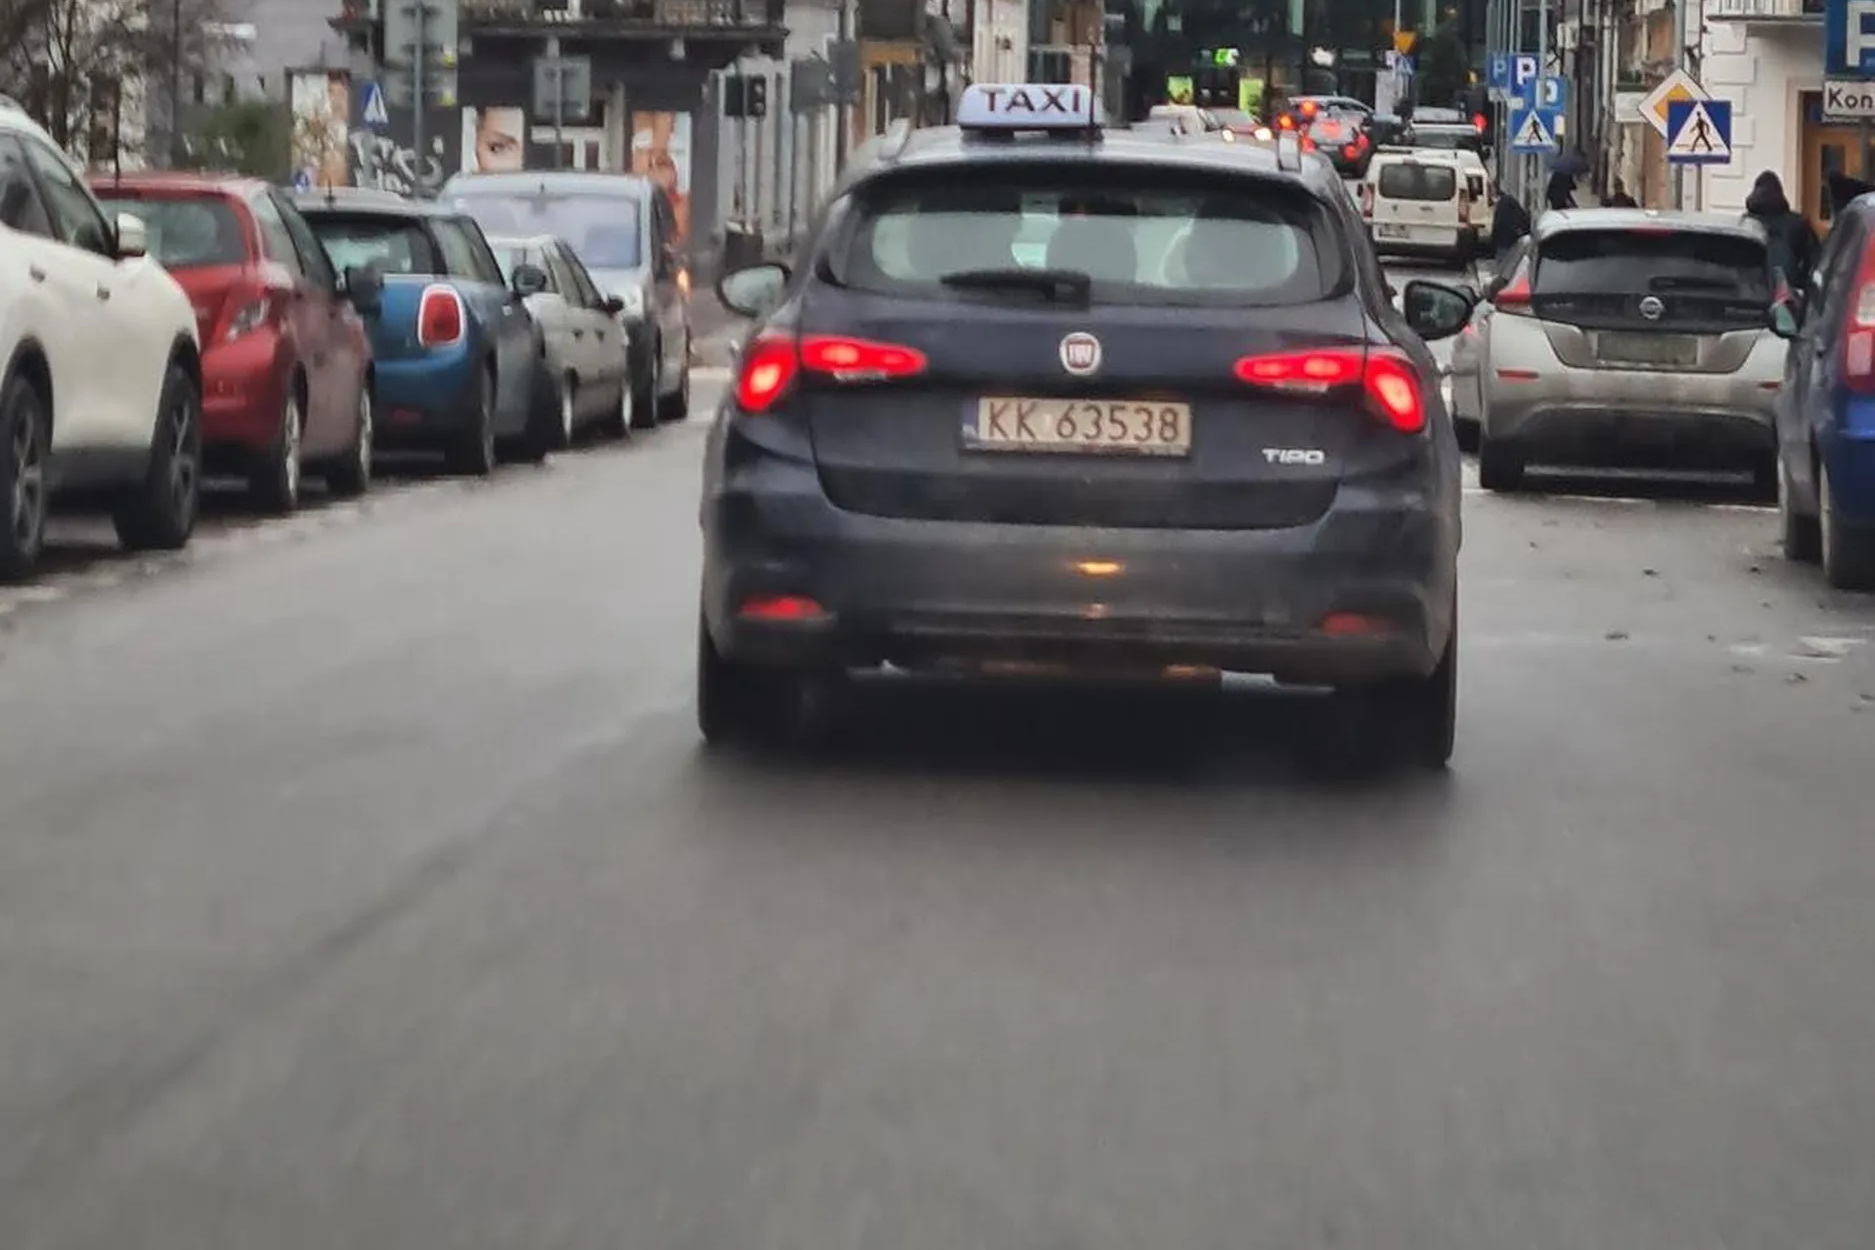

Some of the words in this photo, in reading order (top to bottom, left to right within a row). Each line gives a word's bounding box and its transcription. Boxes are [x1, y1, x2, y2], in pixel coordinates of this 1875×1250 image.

[1516, 57, 1536, 85] P
[979, 88, 1080, 112] TAXI
[987, 402, 1036, 439] KK
[1056, 405, 1180, 442] 63538
[1261, 448, 1324, 464] TIPO
